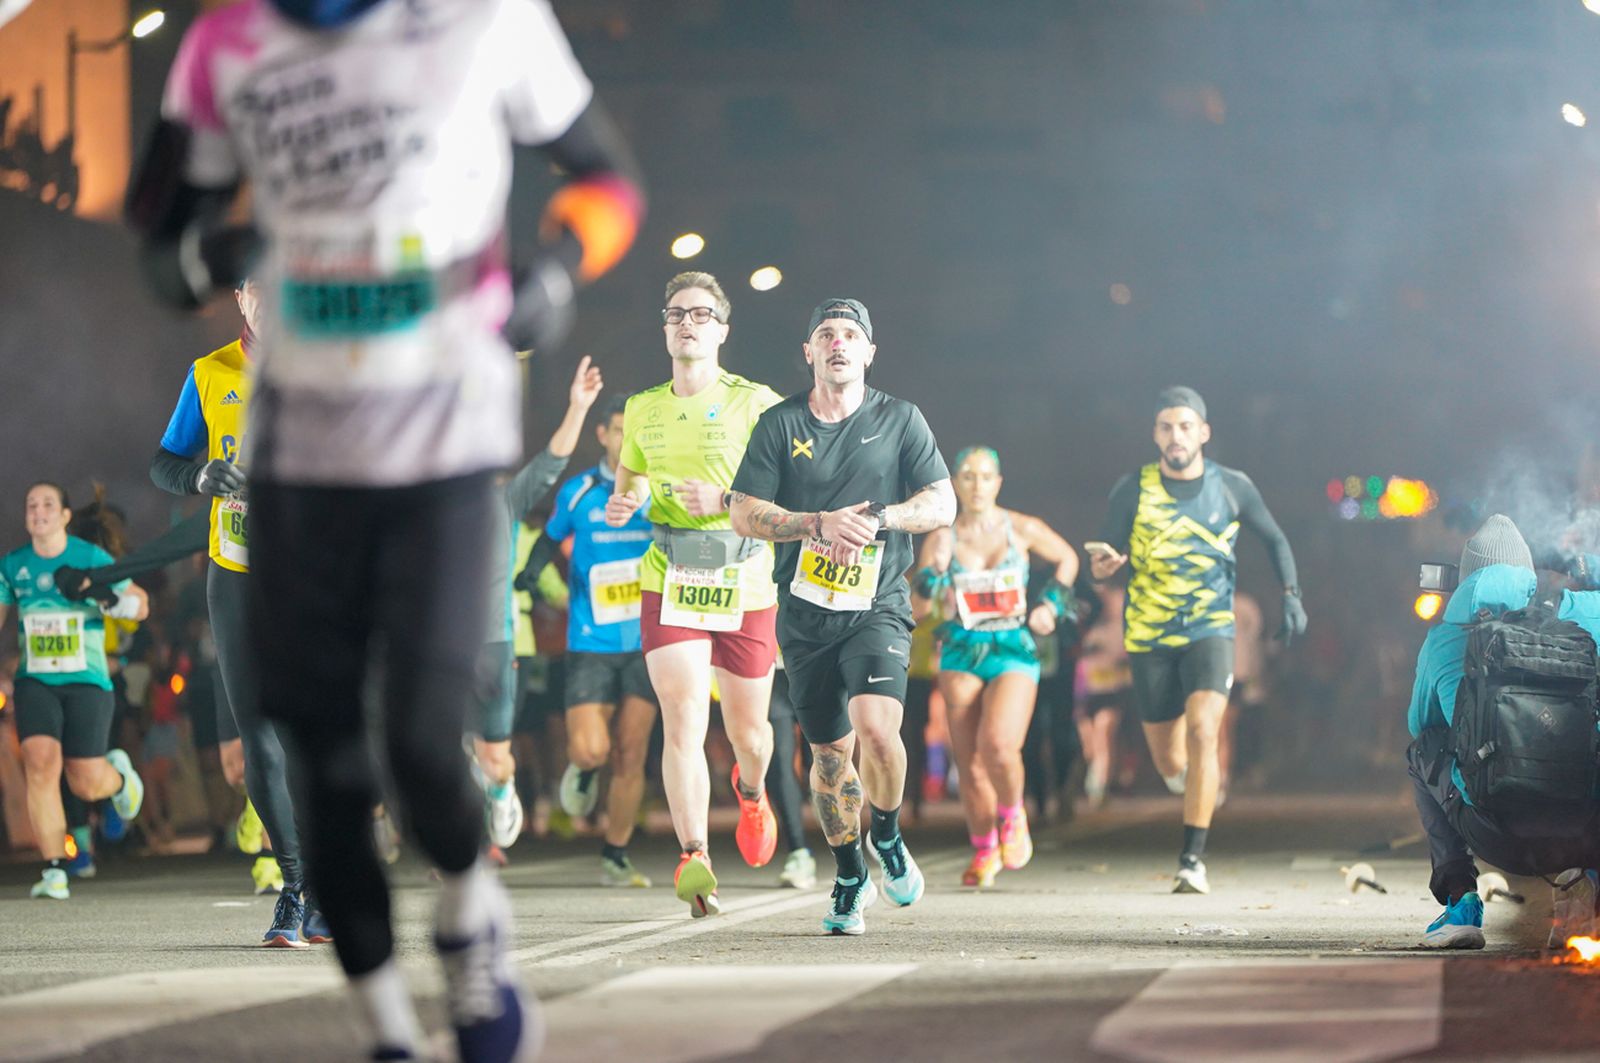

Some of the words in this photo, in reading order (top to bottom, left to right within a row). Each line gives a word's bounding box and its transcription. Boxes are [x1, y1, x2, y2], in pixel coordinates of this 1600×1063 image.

[813, 556, 862, 586] 2873
[676, 585, 733, 608] 13047
[36, 635, 72, 652] 3261
